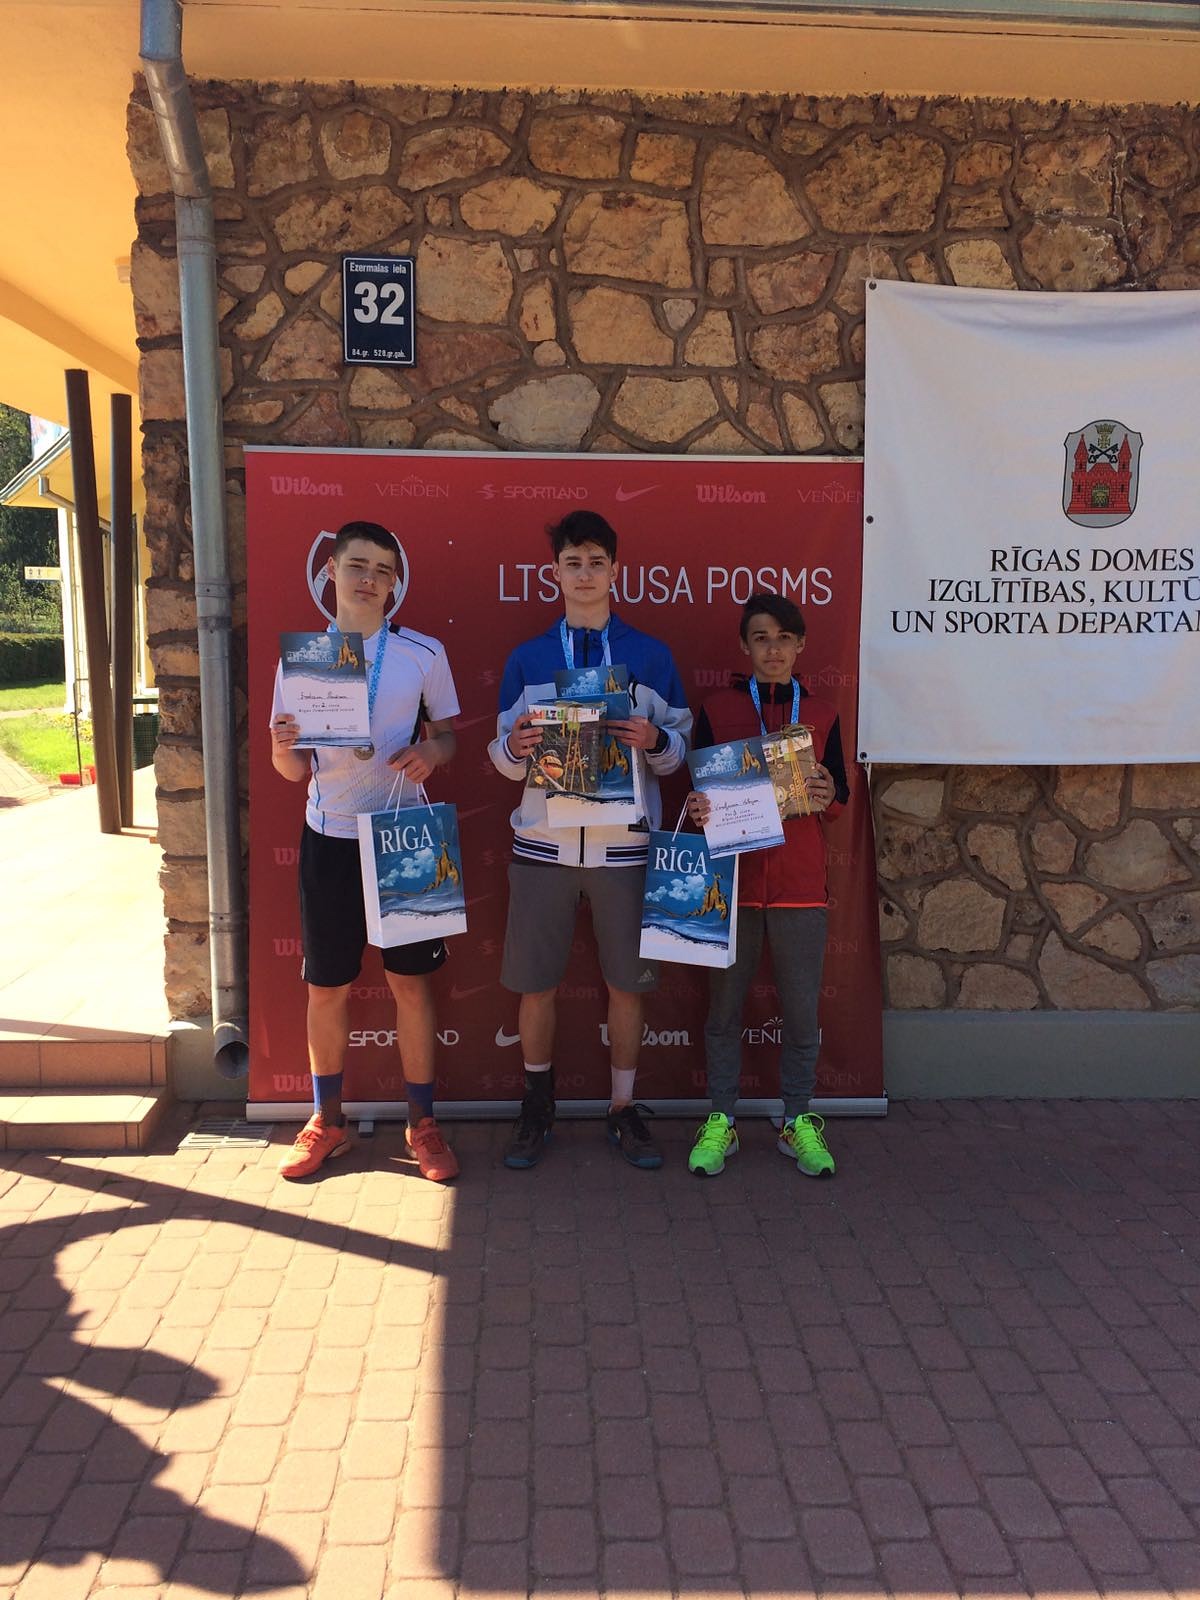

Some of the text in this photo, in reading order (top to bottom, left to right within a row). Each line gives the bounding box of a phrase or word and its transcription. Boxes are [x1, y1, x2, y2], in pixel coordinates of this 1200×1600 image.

[350, 262, 407, 274] Ezermalas iela
[353, 281, 405, 325] 32
[270, 476, 344, 497] Wilson
[376, 482, 450, 498] VENDEN
[503, 485, 589, 500] SPORTLAND
[696, 483, 767, 504] Wilson
[990, 546, 1194, 572] RĪGAS DOMES
[499, 564, 562, 603] LTS
[706, 566, 833, 606] POSMS
[928, 578, 1096, 606] IZGLĪTĪBAS,
[891, 610, 1200, 634] UN SPORTA DEPARTA
[694, 669, 732, 688] Wil
[379, 824, 435, 855] RĪGA
[654, 846, 709, 876] RĪGA
[273, 1073, 312, 1092] Wil
